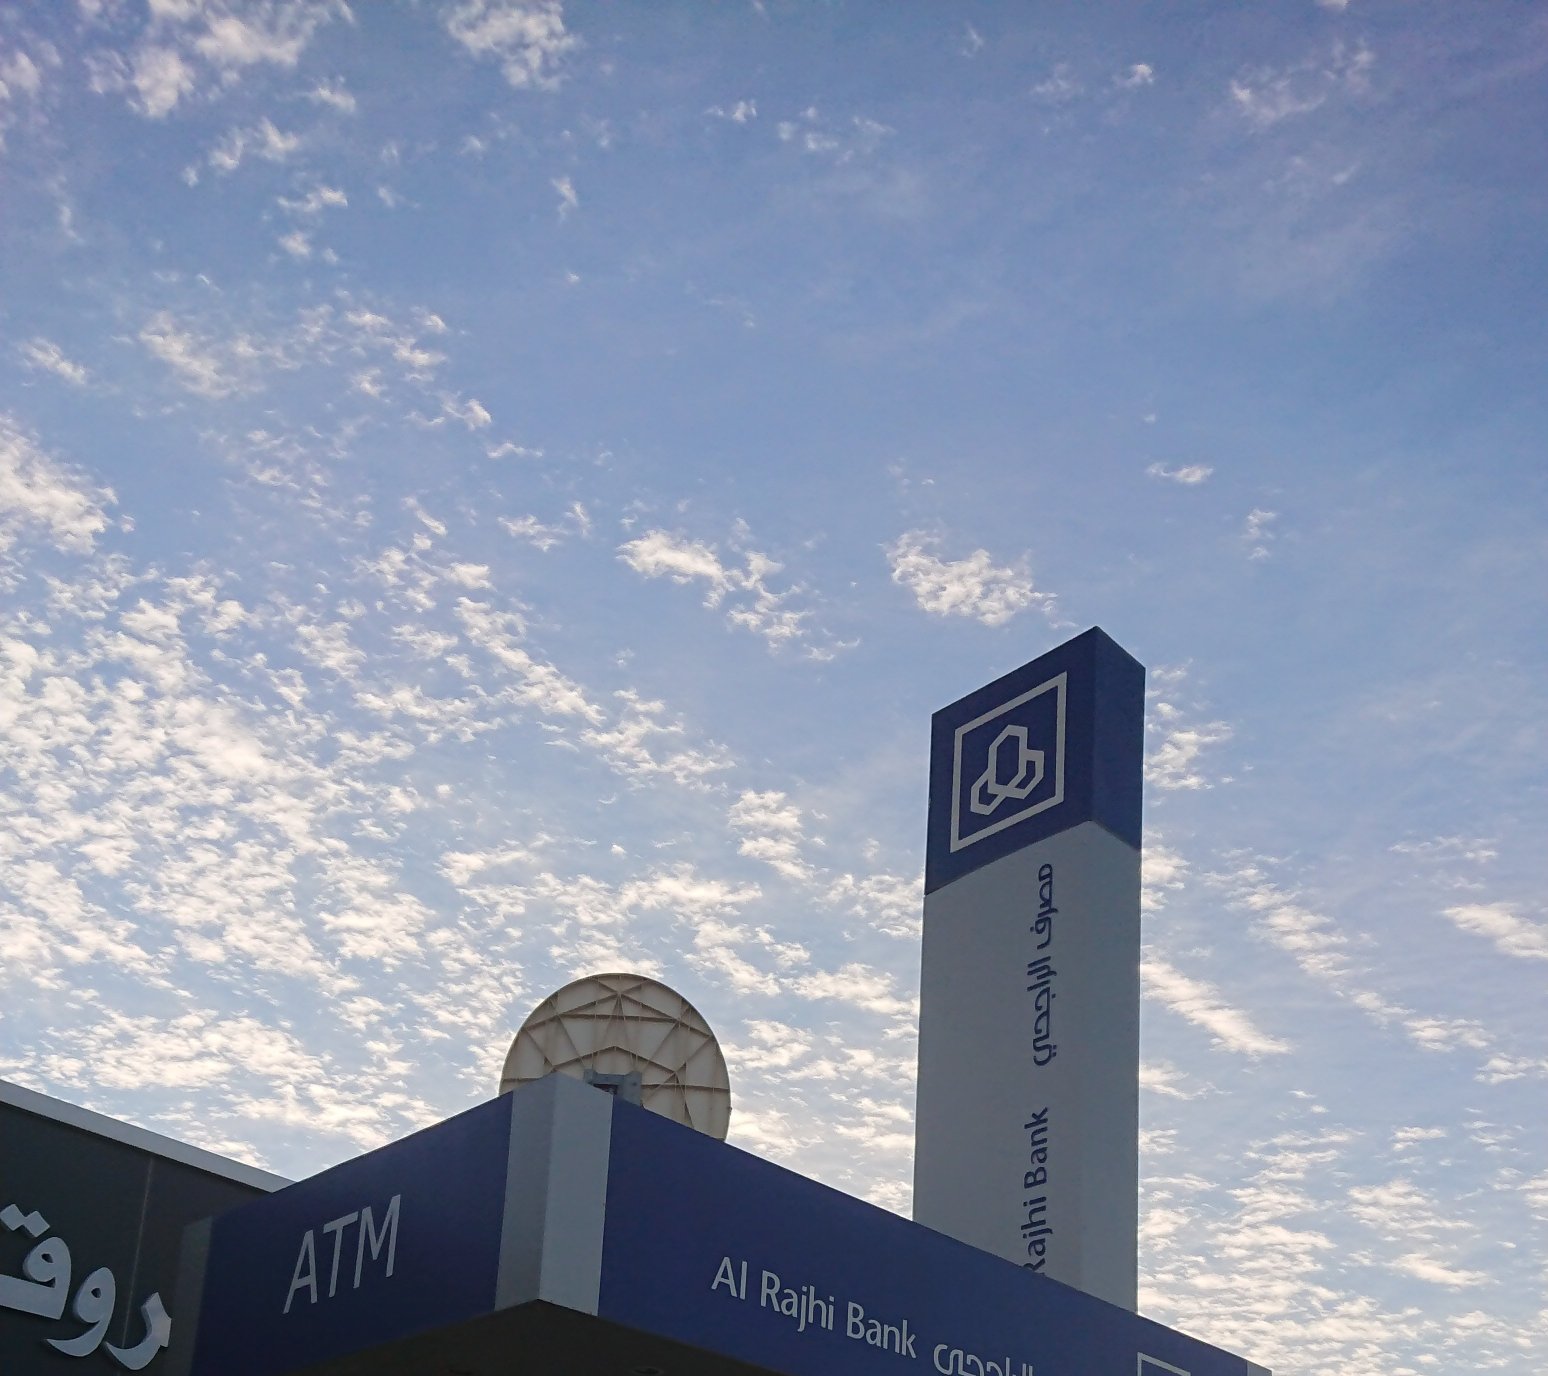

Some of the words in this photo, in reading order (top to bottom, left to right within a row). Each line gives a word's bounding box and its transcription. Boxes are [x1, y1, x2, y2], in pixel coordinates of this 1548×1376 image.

[1030, 863, 1059, 950] مصرف
[1027, 956, 1058, 1066] الراجحي
[1024, 1107, 1049, 1189] Bank
[282, 1194, 400, 1314] ATM
[711, 1256, 748, 1300] Al
[760, 1270, 835, 1332] Rajhi
[846, 1301, 917, 1359] Bank
